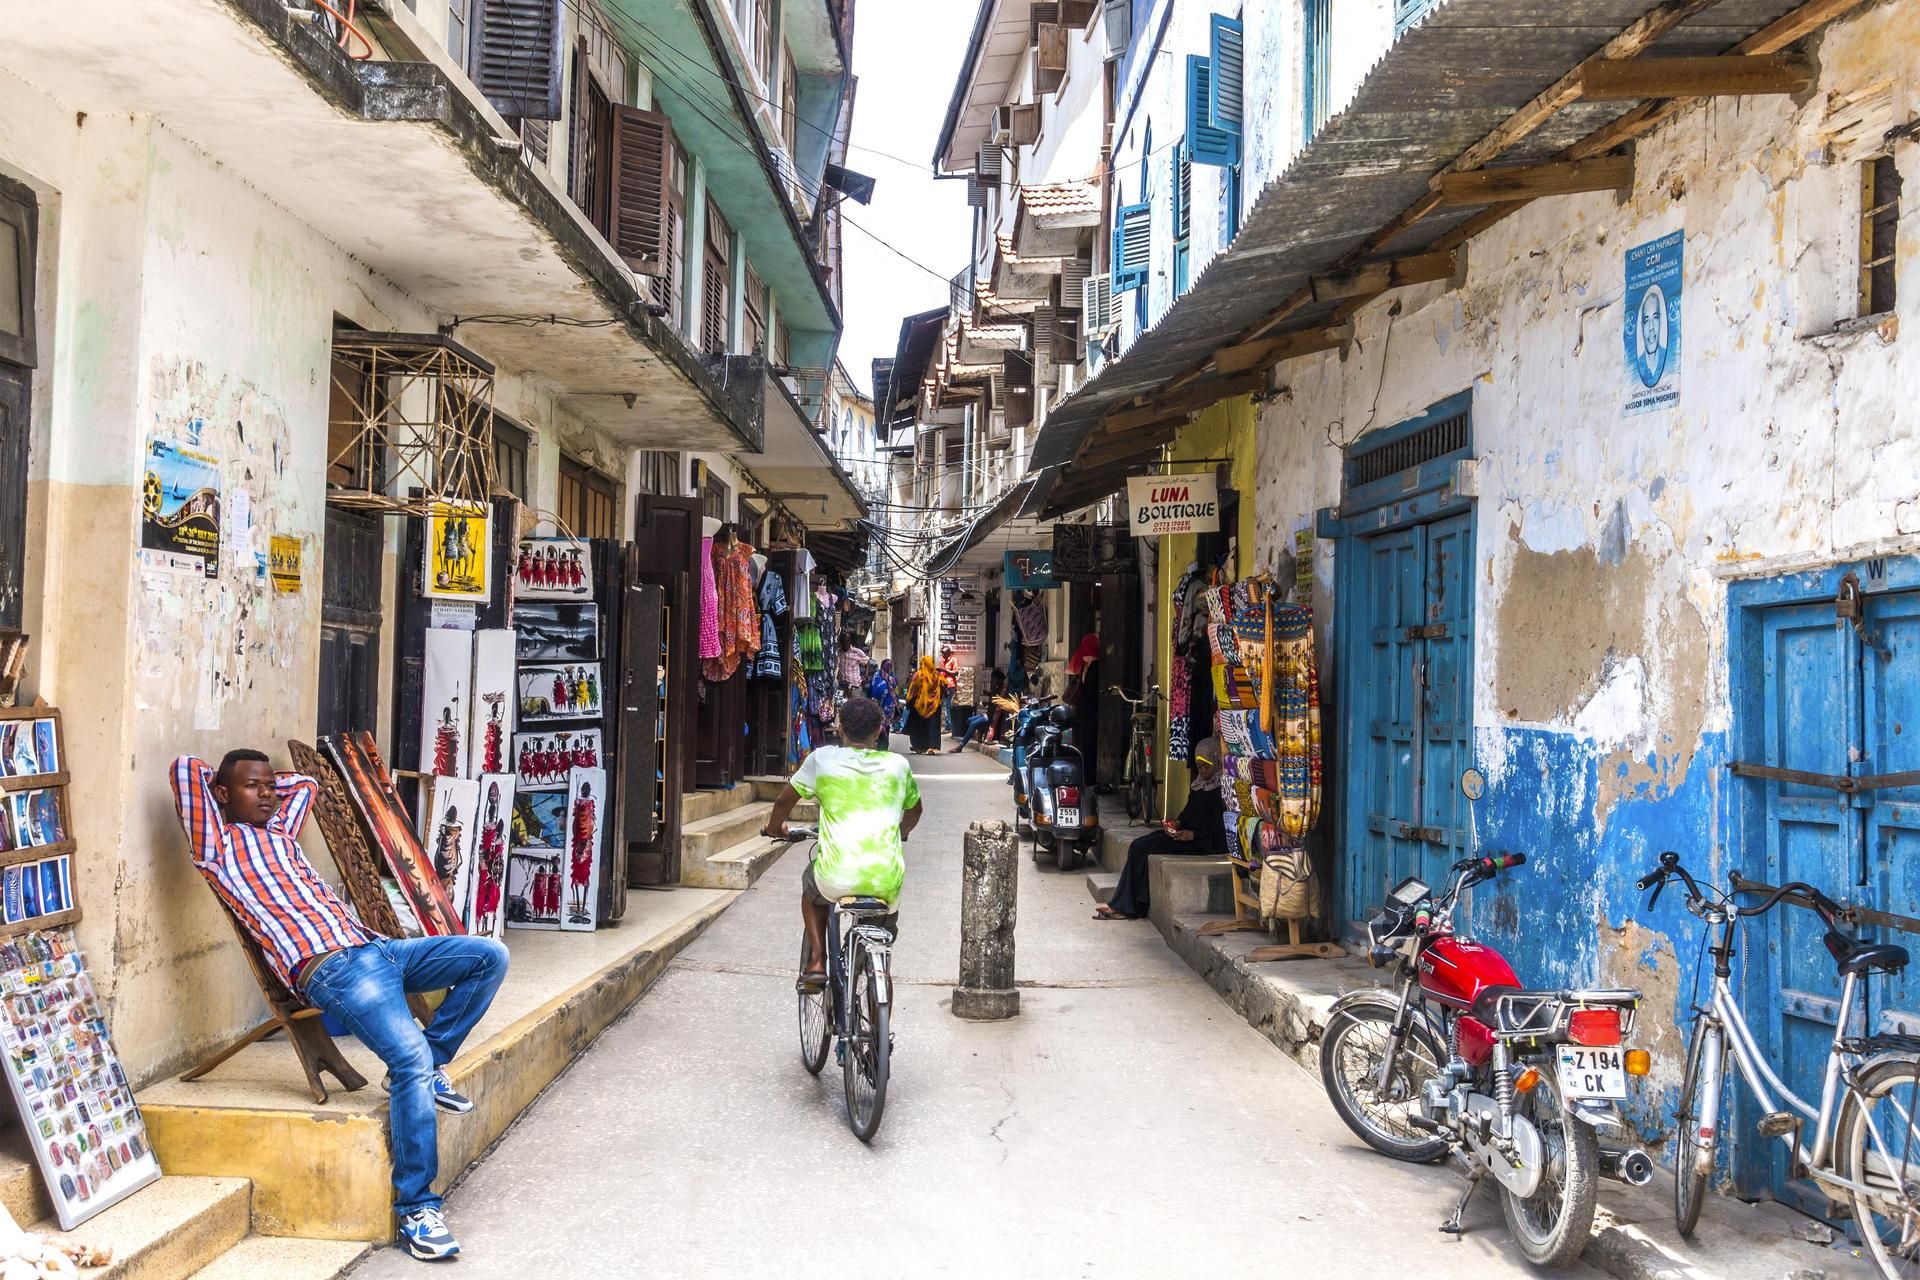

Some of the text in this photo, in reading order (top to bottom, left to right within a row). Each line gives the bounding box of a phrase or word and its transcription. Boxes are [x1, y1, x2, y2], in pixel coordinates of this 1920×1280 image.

[1645, 253, 1661, 267] CCM
[1625, 400, 1642, 410] NASSOR
[1643, 397, 1656, 408] JUMA
[1151, 487, 1189, 503] LUNA
[1137, 502, 1215, 524] BOUTIQUE
[1868, 559, 1883, 580] W
[1576, 1051, 1620, 1070] Z 194
[1584, 1074, 1605, 1092] CK
